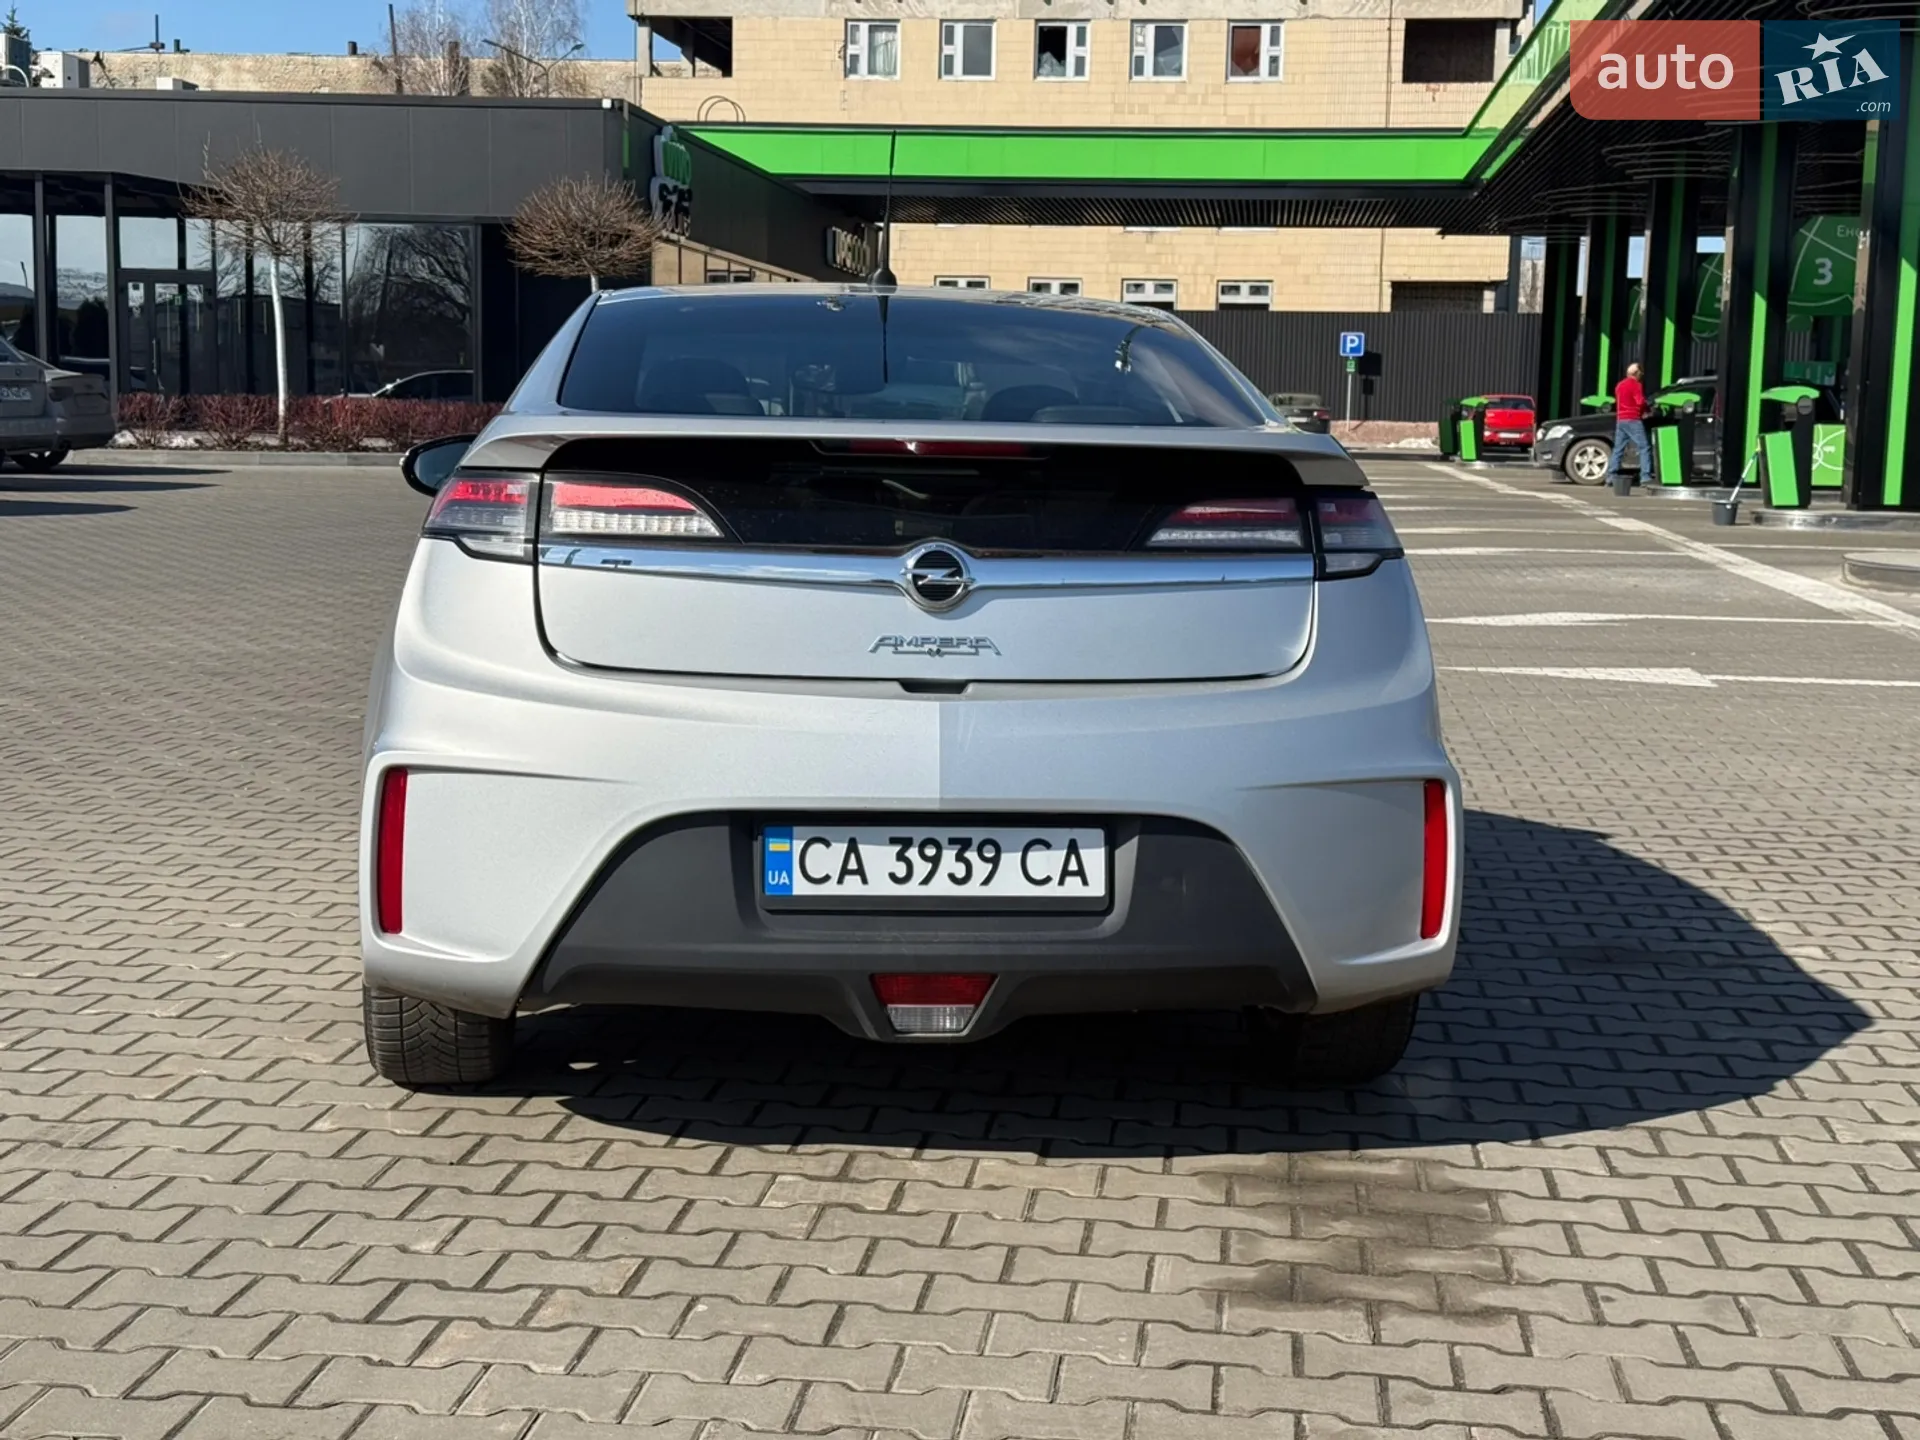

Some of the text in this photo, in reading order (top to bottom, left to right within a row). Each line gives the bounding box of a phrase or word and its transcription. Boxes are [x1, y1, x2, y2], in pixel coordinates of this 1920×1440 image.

[1813, 257, 1834, 286] 3
[1346, 335, 1359, 353] P
[868, 633, 1002, 656] AMPERA
[798, 836, 1089, 887] CA 3939 CA
[768, 869, 790, 886] UA
